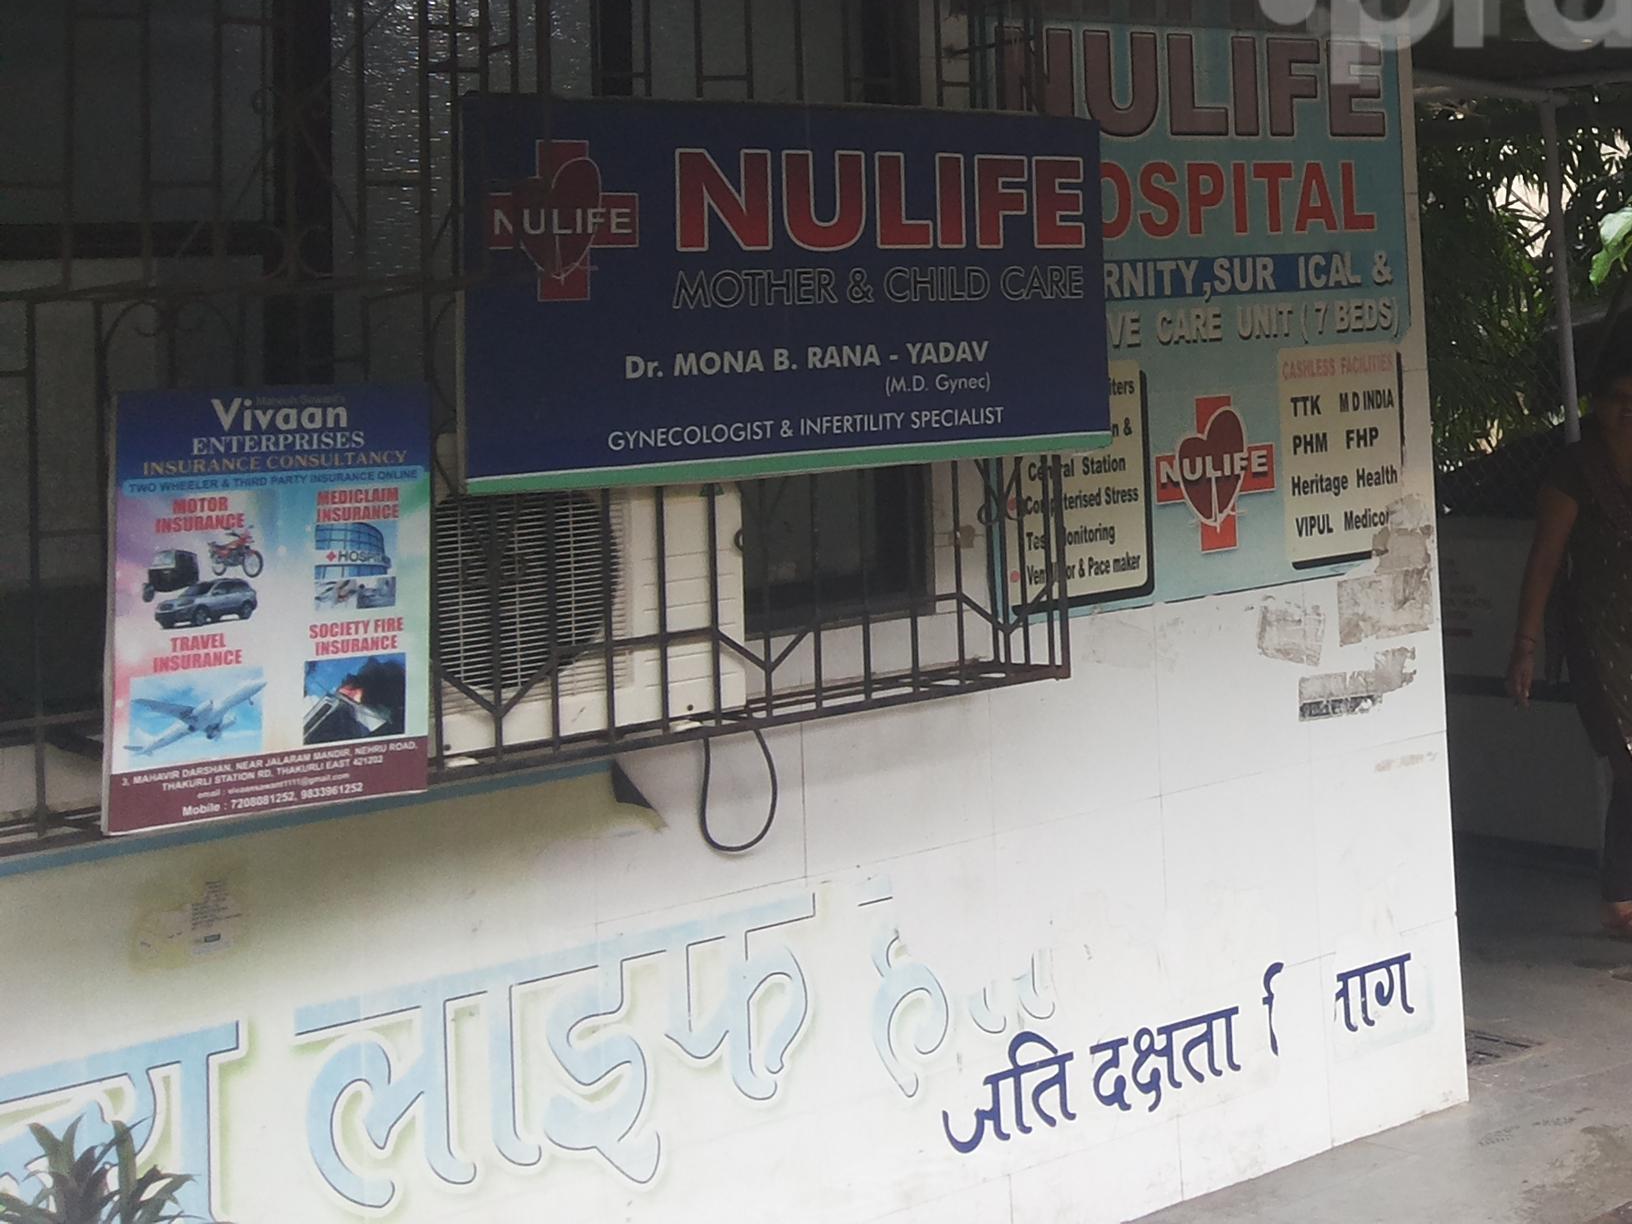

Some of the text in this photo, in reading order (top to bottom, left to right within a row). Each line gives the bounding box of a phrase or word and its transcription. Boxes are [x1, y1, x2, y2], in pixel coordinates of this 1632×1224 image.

[674, 147, 1087, 252] NULIFE
[493, 207, 633, 235] NULIFE
[1372, 250, 1394, 286] &
[672, 265, 1085, 310] MOTHER & CHILD CARE
[1157, 310, 1223, 343] CARE
[1237, 307, 1293, 341] UNIT
[1336, 298, 1399, 339] BEDS)
[625, 354, 664, 379] Dr.
[673, 349, 765, 377] MONA
[772, 348, 799, 372] B.
[807, 344, 881, 369] RANA
[905, 340, 990, 365] YADAV
[1282, 352, 1394, 380] CASHLESS FACILITIES
[885, 372, 991, 397] (M.D. Gynec)
[210, 396, 348, 432] Vivaan
[1290, 394, 1322, 418] TTK
[607, 406, 1005, 451] GYNECOLOGIST & INFERTILITY SPECIALIST
[1292, 426, 1380, 456] PHM FHP
[192, 430, 366, 456] ENTERPRISES
[143, 449, 408, 476] INSURANCE CONSULTANCY
[1082, 455, 1126, 476] Station
[1159, 448, 1270, 489] NULIFE
[129, 482, 157, 493] TWO
[160, 479, 218, 492] WHEELER
[234, 477, 268, 488] THIRD
[270, 474, 307, 486] PARTY
[310, 471, 374, 484] INSURANCE
[377, 469, 419, 481] ONLINE
[1291, 464, 1399, 497] Heritage Health
[172, 496, 229, 515] MOTOR
[315, 487, 399, 506] MEDICLAIM
[1104, 487, 1139, 506] Stress
[155, 513, 246, 534] INSURANCE
[315, 504, 400, 523] INSURANCE
[1295, 513, 1334, 538] VIPUL
[1026, 523, 1116, 551] Tes onitoring
[1078, 559, 1086, 579] &
[1087, 557, 1112, 577] Pace
[1112, 551, 1141, 572] maker
[309, 617, 404, 639] SOCIETY FIRE
[170, 633, 226, 653] TRAVEL
[315, 635, 398, 656] INSURANCE
[153, 649, 243, 673] INSURANCE
[214, 772, 256, 786] STATION
[325, 758, 351, 771] EAST
[182, 802, 221, 818] Mobile
[1090, 1006, 1243, 1113] दक्षता
